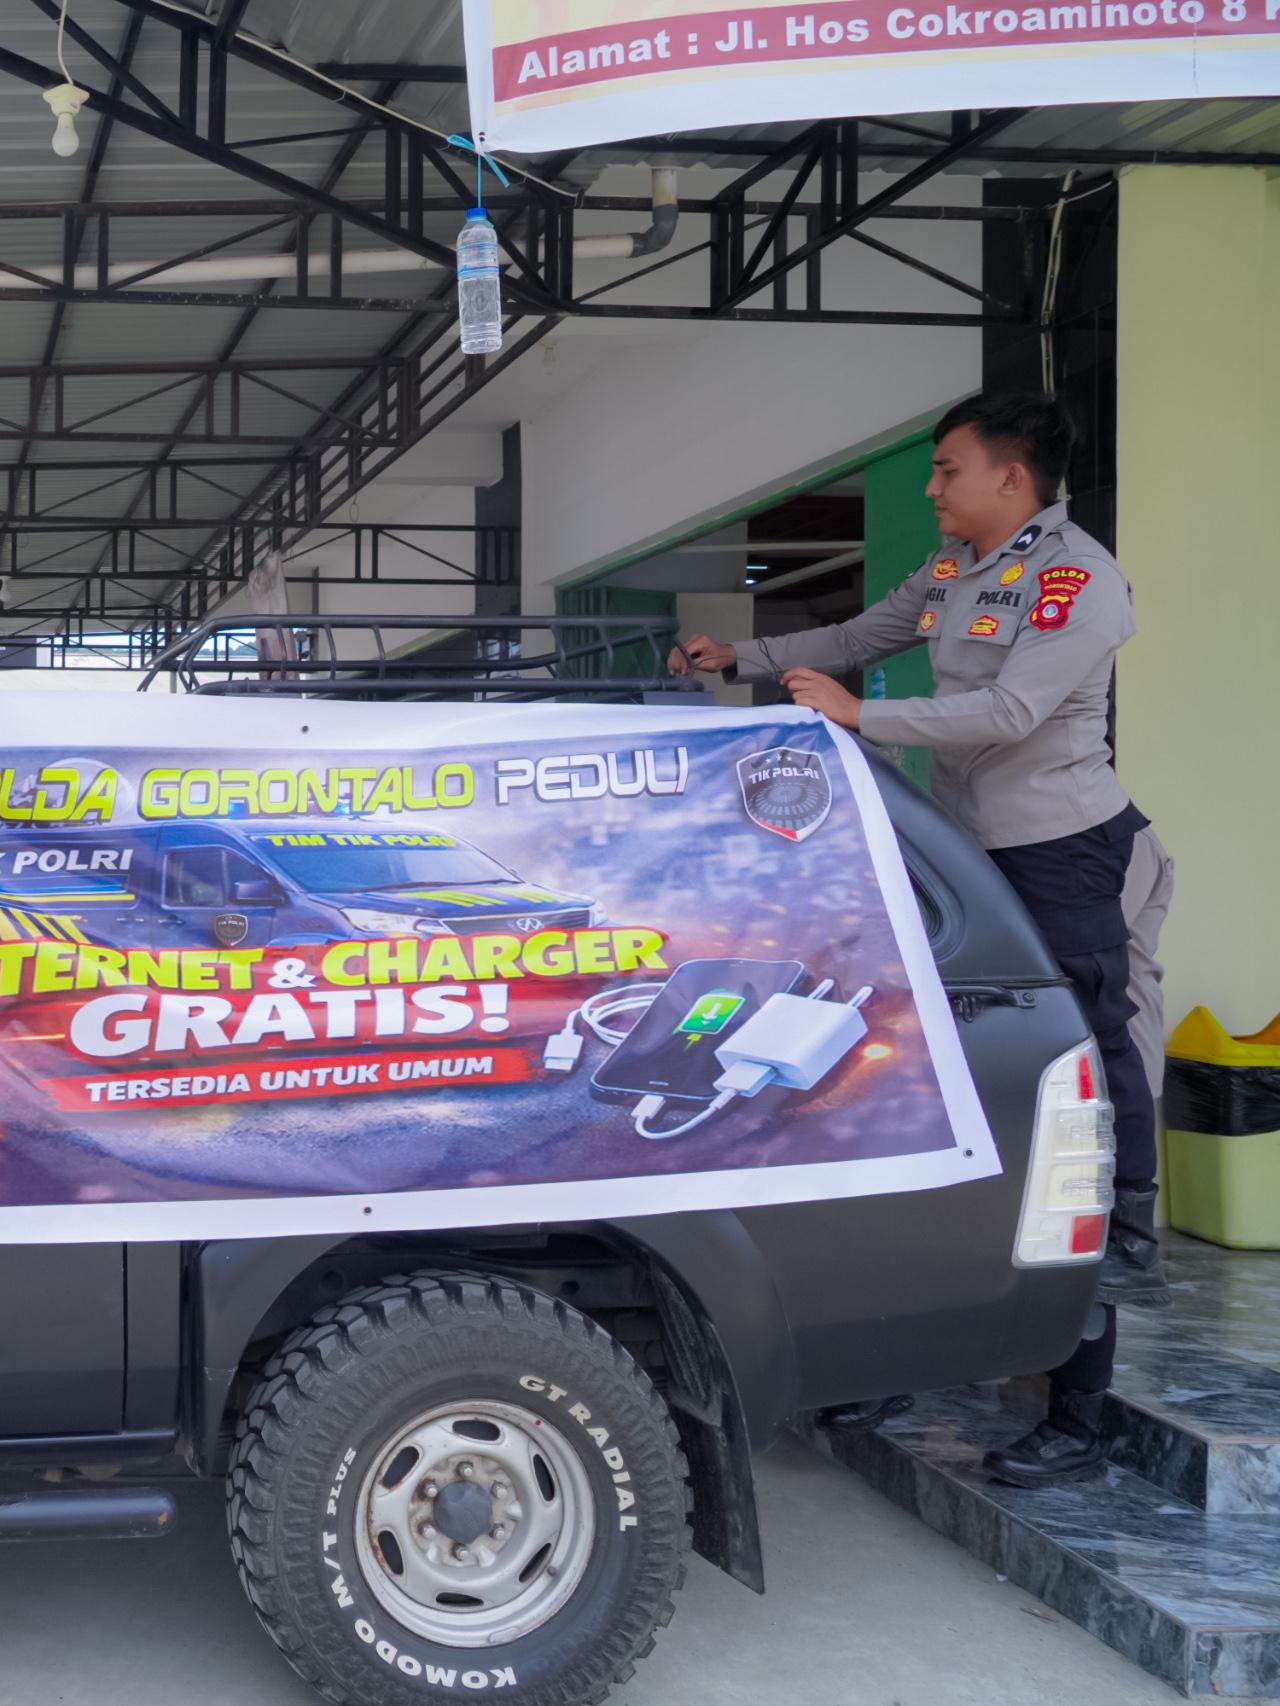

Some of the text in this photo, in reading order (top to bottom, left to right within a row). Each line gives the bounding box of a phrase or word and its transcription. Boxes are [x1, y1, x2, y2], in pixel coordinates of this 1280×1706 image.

[518, 29, 671, 84] Alamat
[715, 21, 768, 52] Jl.
[786, 16, 870, 46] Hos
[887, 0, 1205, 39] Cokroaminoto
[1222, 0, 1247, 22] 8
[976, 590, 1022, 608] POLRI
[1043, 570, 1085, 582] POLDA
[140, 763, 474, 817] GORONTALO
[497, 747, 688, 804] PEDULI
[748, 767, 820, 785] TIK POLRI
[12, 849, 133, 874] POLRI
[266, 834, 327, 847] TIM
[327, 834, 381, 847] TIK
[268, 957, 317, 989] &
[321, 929, 668, 987] CHARGER
[71, 984, 510, 1057] GRATIS!
[86, 1056, 493, 1103] TERSEDIA UNTUK UMUM
[327, 1447, 357, 1517] PLUS
[520, 1375, 638, 1532] GT RADIAL
[354, 1618, 517, 1690] KOMODO
